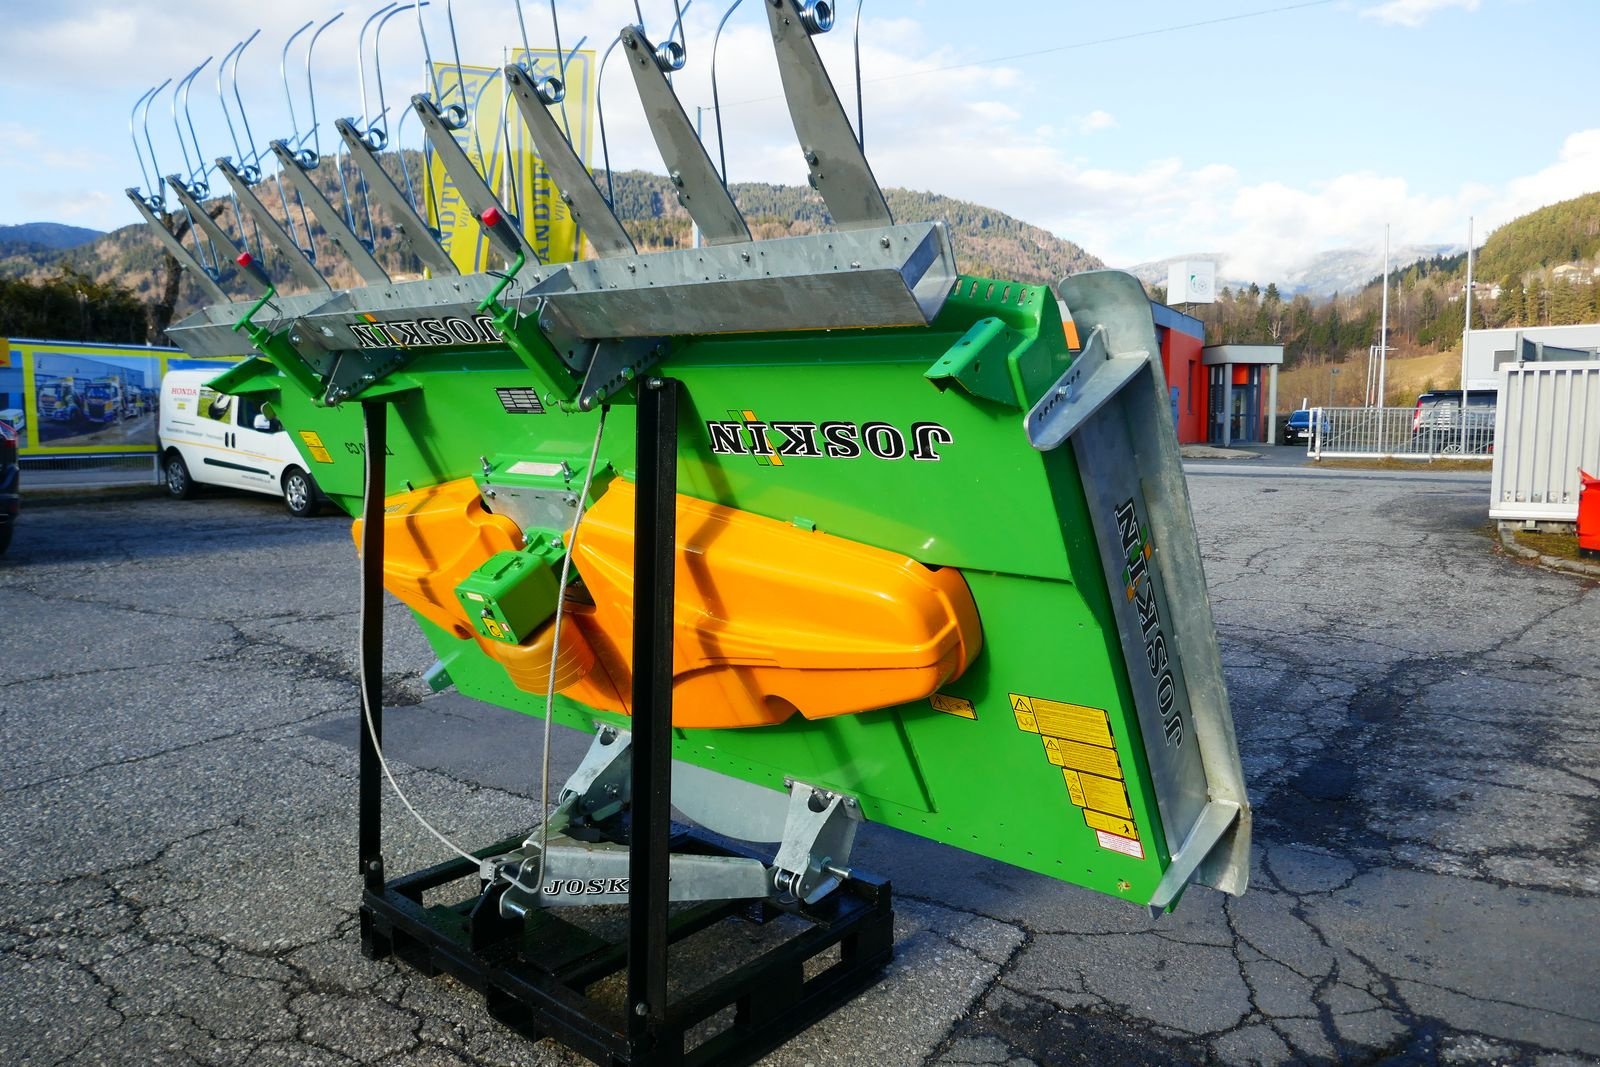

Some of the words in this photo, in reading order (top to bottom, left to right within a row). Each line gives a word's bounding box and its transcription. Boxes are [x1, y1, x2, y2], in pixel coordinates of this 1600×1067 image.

[348, 315, 503, 349] JOSKIN
[171, 387, 197, 396] HONDA
[706, 420, 953, 461] JOSKIN
[1114, 497, 1184, 749] JOSKIN
[543, 877, 630, 896] JOSK
